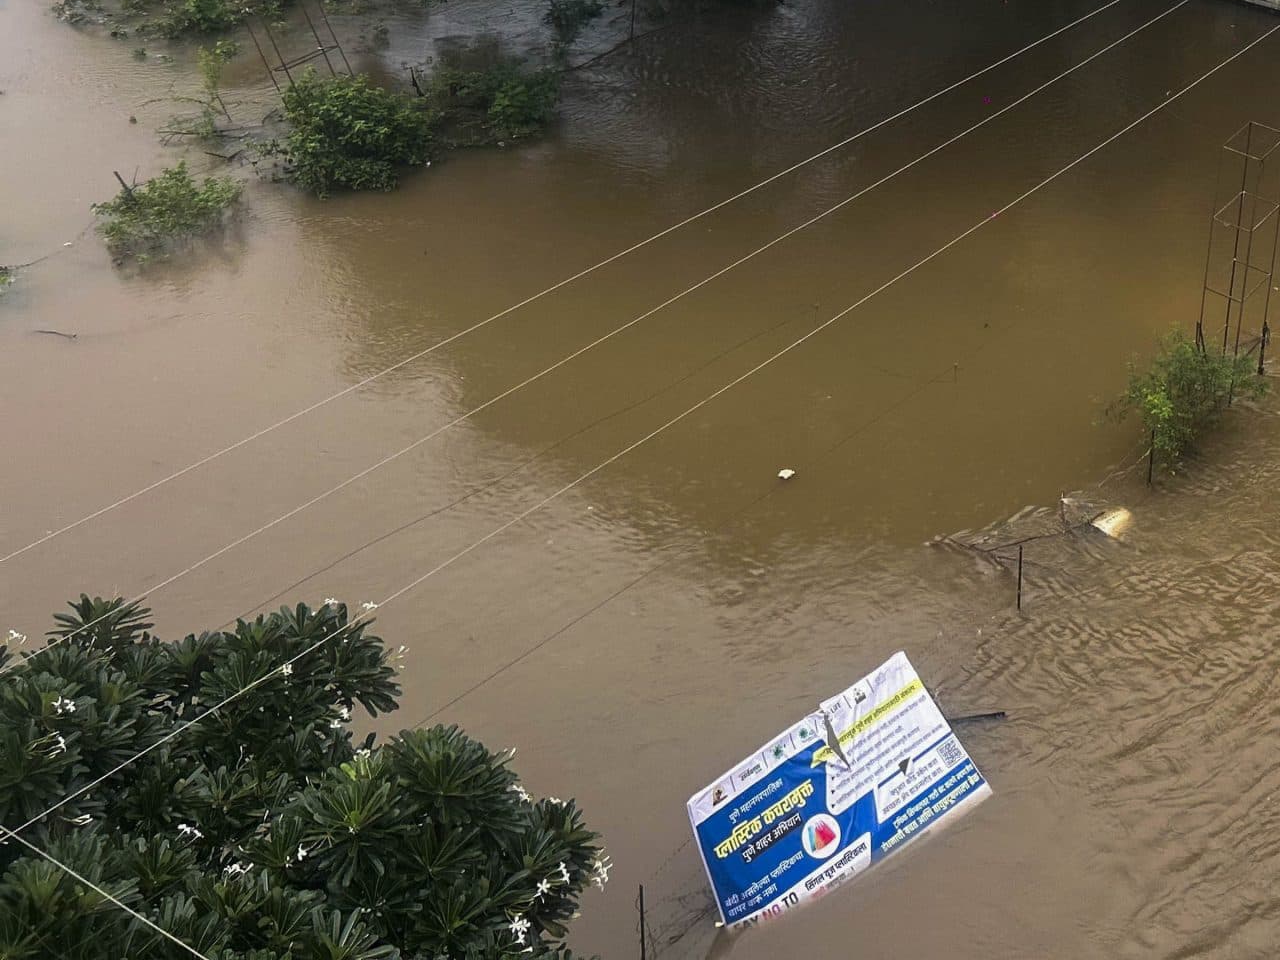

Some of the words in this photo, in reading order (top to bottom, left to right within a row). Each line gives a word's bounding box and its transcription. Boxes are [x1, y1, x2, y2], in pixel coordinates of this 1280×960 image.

[713, 815, 763, 859] प्लास्टिक
[762, 778, 815, 824] कचरामुक्त
[728, 807, 741, 824] पुणे
[742, 846, 756, 863] पुणे
[756, 835, 773, 854] शहर
[772, 813, 802, 842] अभियान
[781, 892, 799, 908] TO
